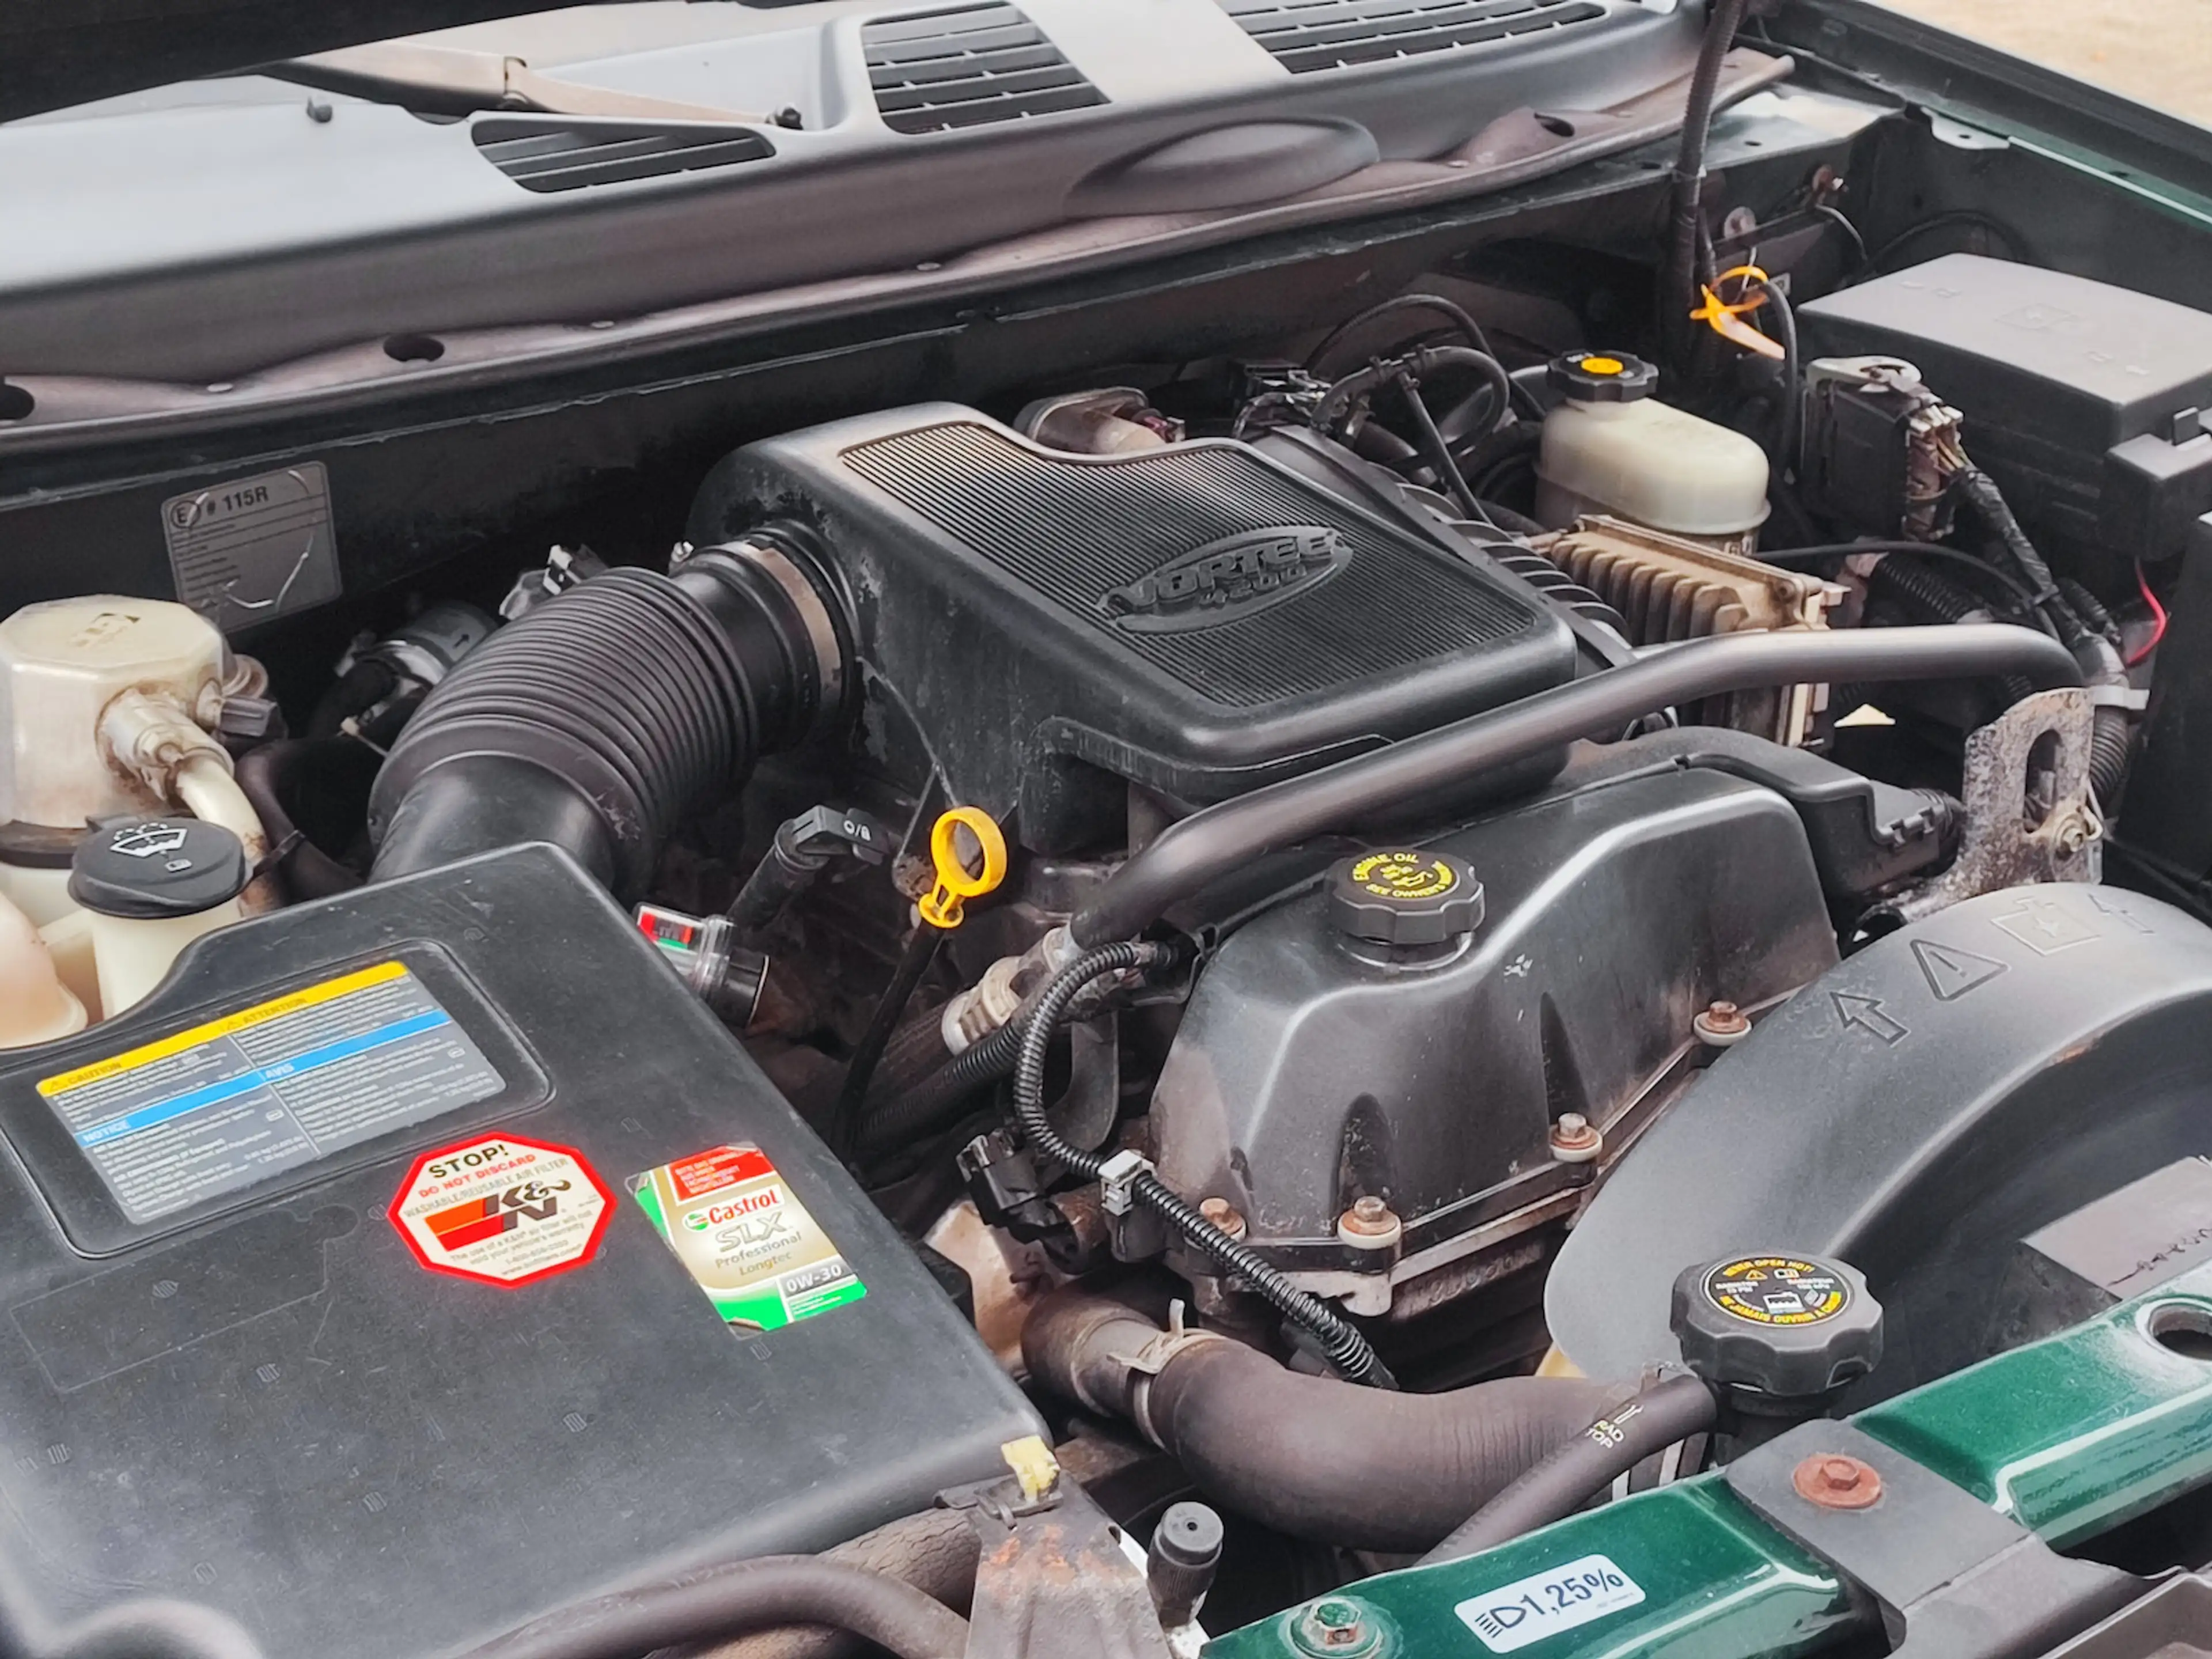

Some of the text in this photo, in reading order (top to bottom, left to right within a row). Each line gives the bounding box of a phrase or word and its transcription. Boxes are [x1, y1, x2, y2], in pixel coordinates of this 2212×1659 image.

[222, 486, 269, 511] 115R
[1393, 853, 1419, 863] OIL
[240, 996, 308, 1024] ATTENTION
[66, 1060, 123, 1085] CAUTION
[263, 1063, 296, 1079] AVIS
[81, 1120, 131, 1143] NOTICE
[429, 1143, 509, 1177] STOP!
[403, 1156, 569, 1219] WASHABLE/REUSABLE AIR FILTER
[418, 1152, 537, 1199] DO NOT DISCARD
[483, 1179, 571, 1232] K&N
[709, 1189, 780, 1225] Castrol
[715, 1211, 787, 1252] SLX
[715, 1231, 802, 1269] Professional
[739, 1252, 792, 1276] Longtec
[1754, 1259, 1786, 1267] OPEN
[786, 1264, 842, 1293] 0W-30
